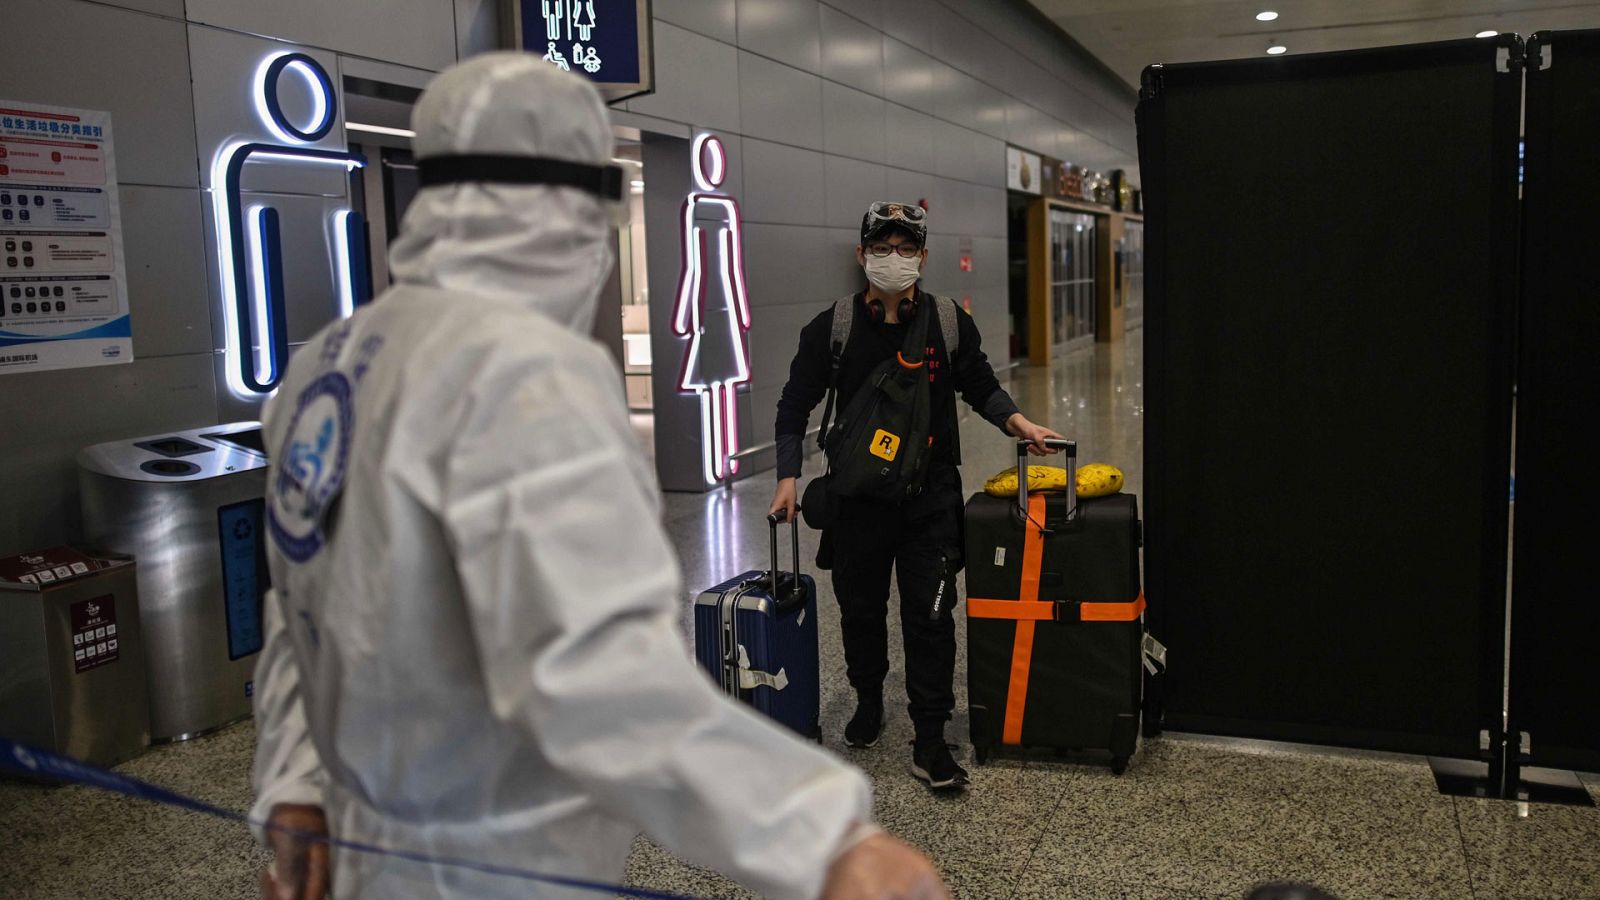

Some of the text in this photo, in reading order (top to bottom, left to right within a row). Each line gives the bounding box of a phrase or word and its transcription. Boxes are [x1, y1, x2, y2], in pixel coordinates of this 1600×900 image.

[0, 117, 103, 137] 位生活垃圾分类指引
[879, 434, 892, 449] R
